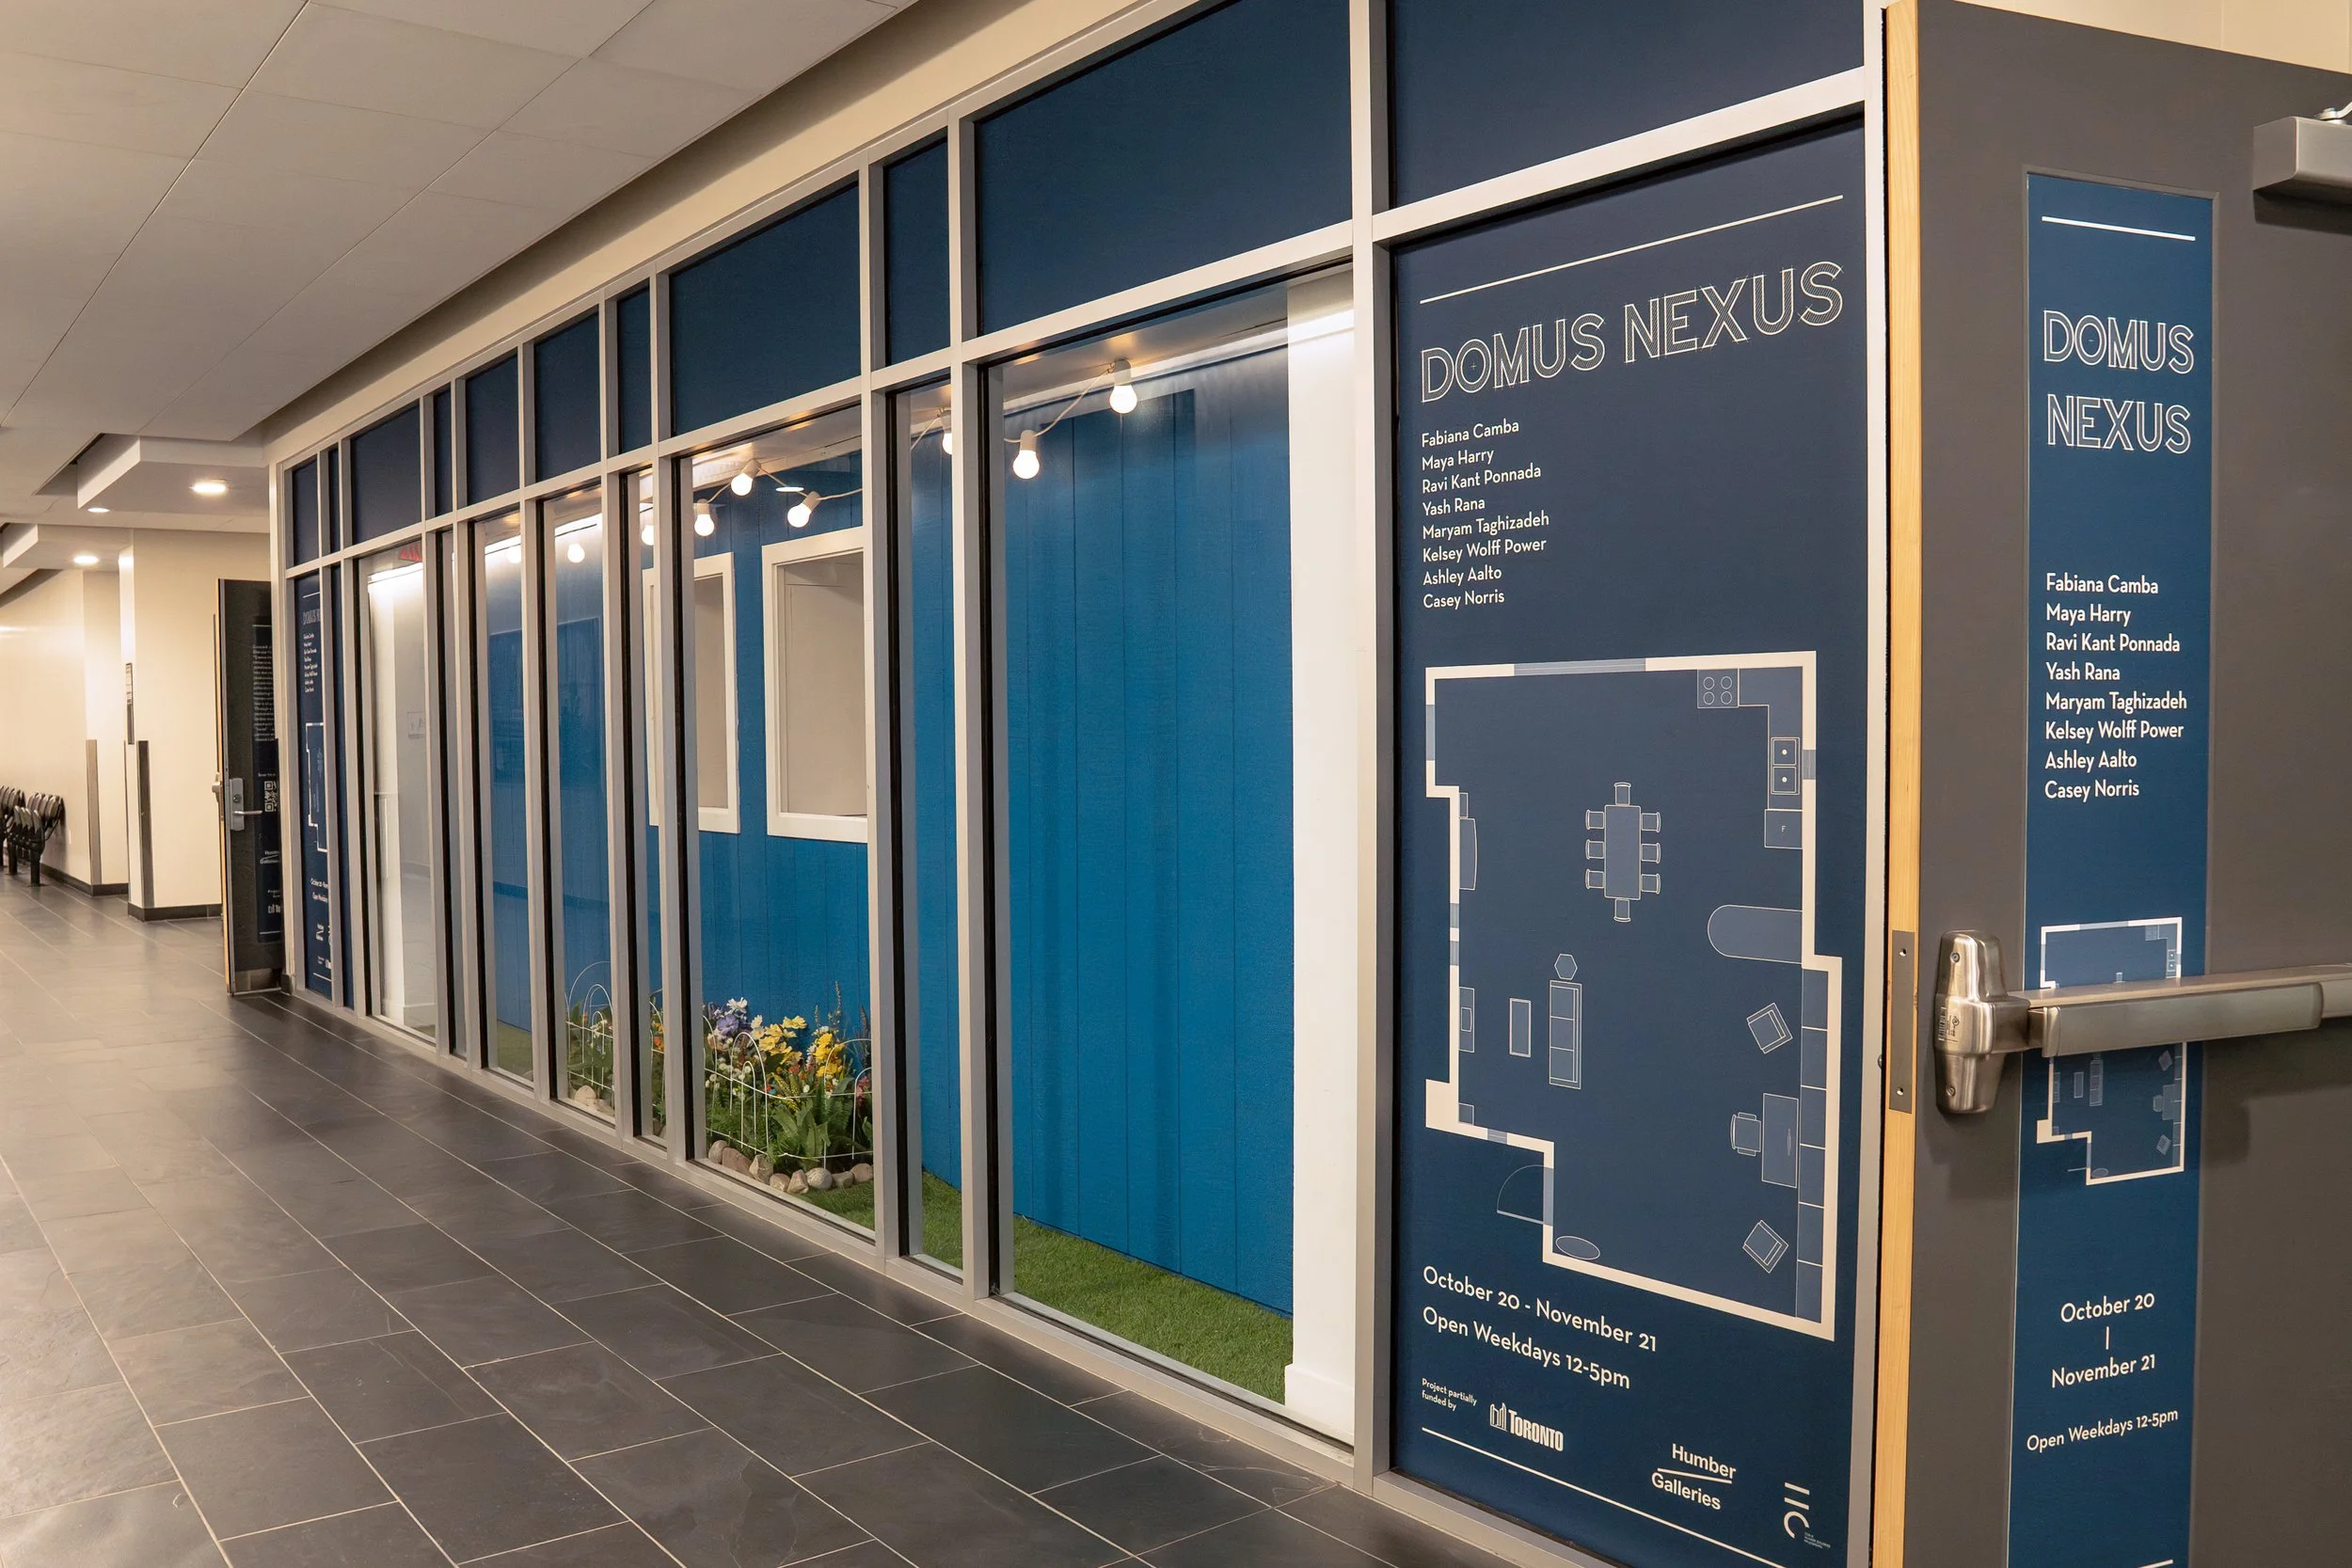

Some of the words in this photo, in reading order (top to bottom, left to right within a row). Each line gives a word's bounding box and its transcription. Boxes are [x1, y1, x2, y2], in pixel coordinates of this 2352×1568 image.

[1421, 312, 1605, 403] DOMUS
[1624, 261, 1844, 364] NEXUS
[2042, 309, 2195, 374] DOMUS
[1422, 430, 1470, 448] Fabiana
[1472, 419, 1519, 439] Camba
[2046, 393, 2192, 454] NEXUS
[1422, 455, 1454, 472] Maya
[1457, 450, 1495, 466] Harry
[1422, 477, 1448, 494] Ravi
[1451, 471, 1481, 490] Kant
[1484, 463, 1542, 485] Ponnada
[1422, 499, 1452, 516] Yash
[1454, 498, 1486, 513] Rana
[1422, 524, 1472, 541] Maryam
[1475, 510, 1549, 536] Taghizadeh
[1422, 546, 1463, 563] Kelsey
[1466, 539, 1502, 558] Wolff
[1504, 539, 1548, 555] Power
[1422, 568, 1465, 587] Ashley
[1467, 564, 1502, 582] Aalto
[2046, 572, 2105, 593] Fabiana
[2107, 574, 2159, 594] Camba
[1422, 594, 1462, 610] Casey
[1464, 589, 1505, 606] Norris
[2046, 602, 2086, 626] Maya
[2090, 603, 2132, 627] Harry
[2046, 631, 2077, 651] Ravi
[2081, 632, 2116, 652] Kant
[2120, 632, 2181, 652] Ponnada
[2045, 660, 2081, 681] Yash
[2085, 661, 2121, 681] Rana
[2045, 691, 2106, 715] Maryam
[2108, 689, 2187, 715] Taghizadeh
[2045, 720, 2094, 744] Kelsey
[2097, 719, 2137, 739] Wolff
[2140, 720, 2185, 738] Power
[2044, 749, 2095, 773] Ashley
[2098, 748, 2137, 768] Aalto
[2044, 780, 2091, 803] Casey
[2094, 779, 2140, 798] Norris
[1422, 1265, 1494, 1302] October
[1497, 1291, 1520, 1310] 20
[1536, 1297, 1633, 1344] November
[1638, 1333, 1656, 1352] 21
[2060, 1295, 2131, 1323] October
[2134, 1292, 2155, 1308] 20
[1422, 1306, 1469, 1337] Open
[1472, 1320, 1561, 1368] Weekdays
[1565, 1354, 1630, 1389] 12-5pm
[2051, 1356, 2137, 1388] November
[2140, 1354, 2155, 1371] 21
[1422, 1377, 1447, 1394] Project
[1448, 1389, 1477, 1407] partially
[1422, 1389, 1447, 1406] funded
[1447, 1399, 1457, 1412] by
[1507, 1408, 1565, 1452] TORONTO
[2026, 1434, 2065, 1453] Open
[2068, 1418, 2134, 1442] Weekdays
[2136, 1410, 2178, 1428] 12-5pm
[1672, 1443, 1737, 1480] Humber
[1651, 1471, 1722, 1511] Galleries
